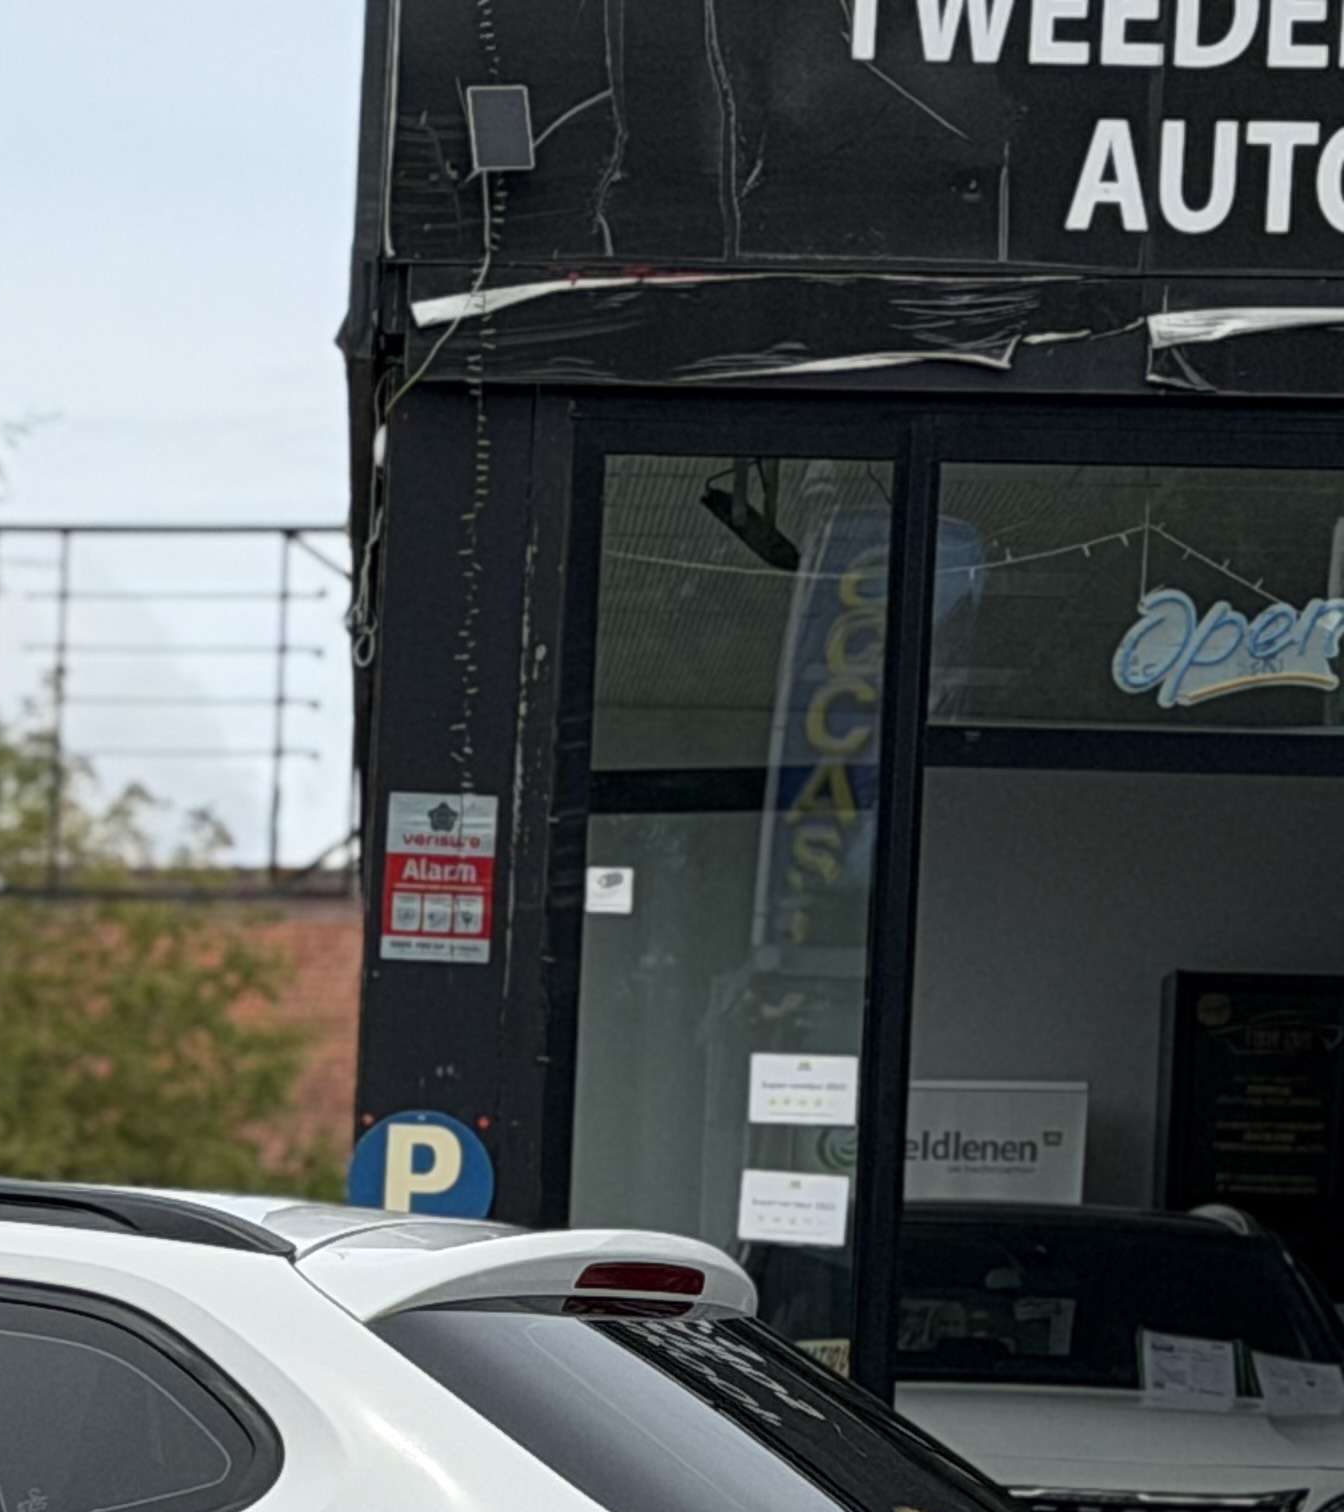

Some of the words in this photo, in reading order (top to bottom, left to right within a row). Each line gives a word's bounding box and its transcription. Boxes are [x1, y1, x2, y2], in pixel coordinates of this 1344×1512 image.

[850, 0, 1344, 68] TWEEDE
[401, 858, 477, 883] Alarm
[384, 1123, 461, 1214] P
